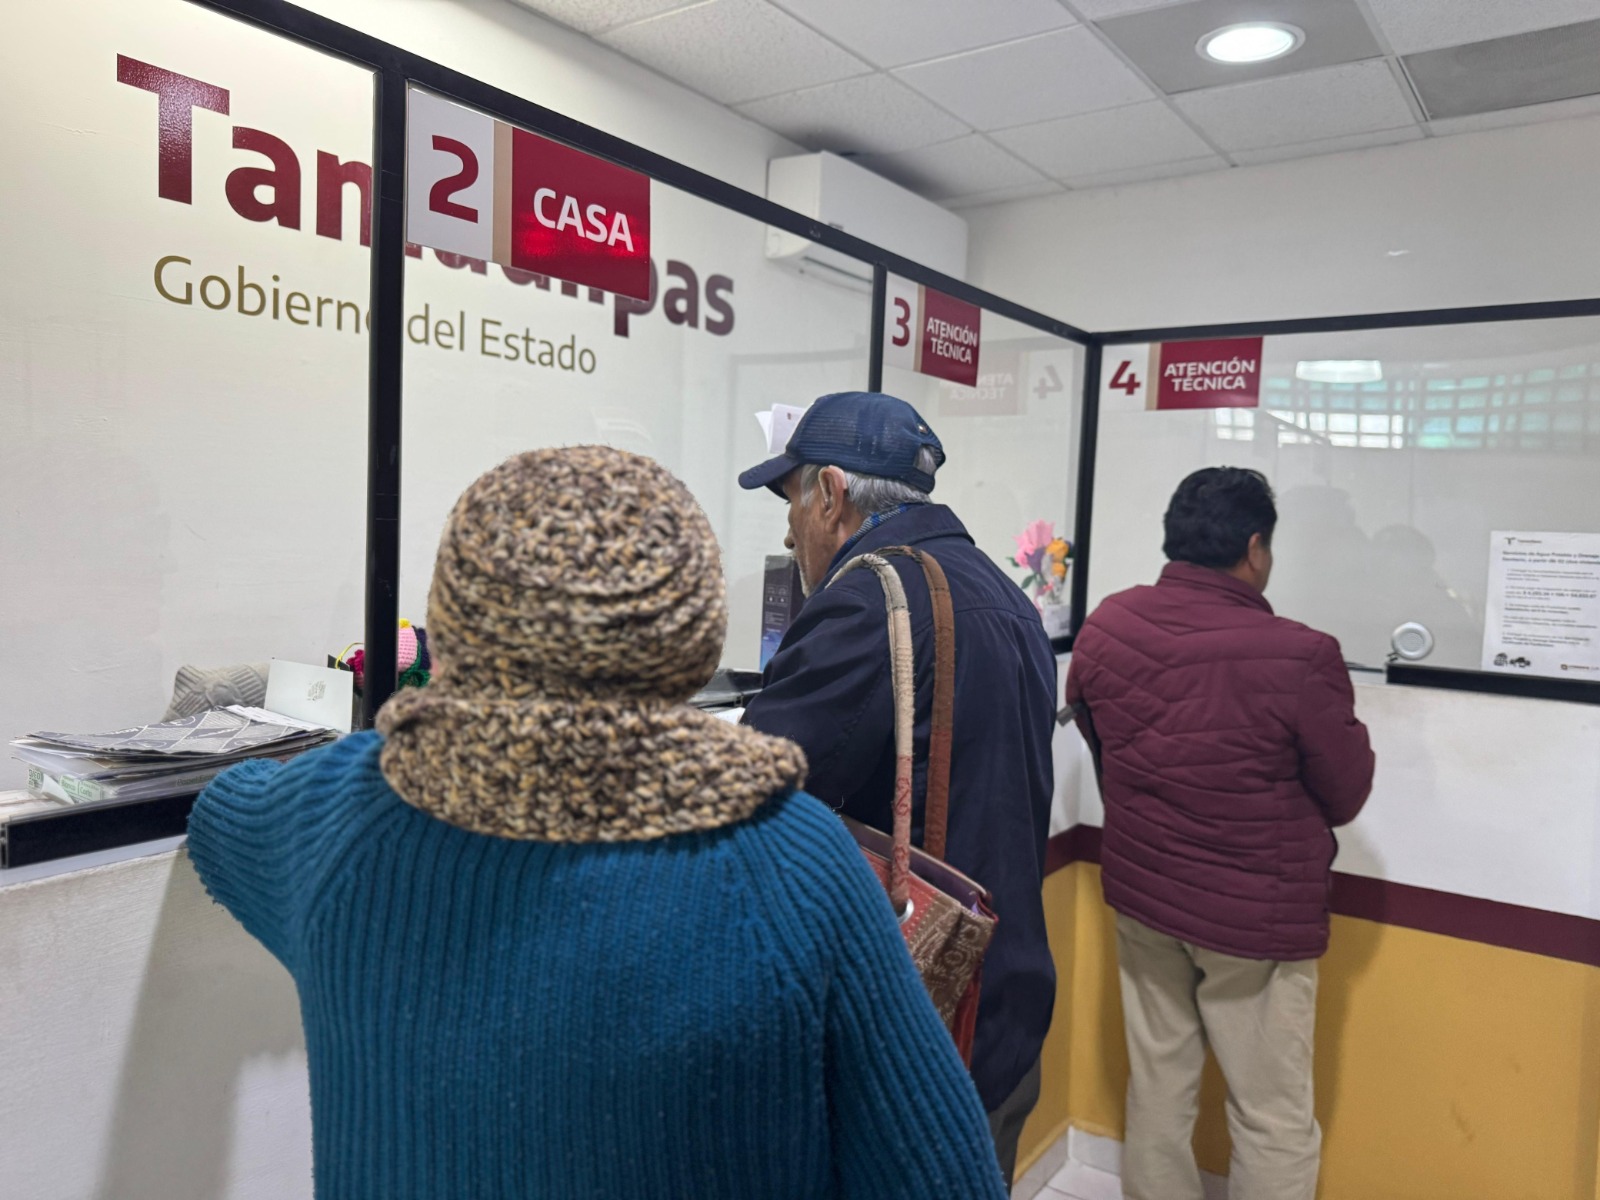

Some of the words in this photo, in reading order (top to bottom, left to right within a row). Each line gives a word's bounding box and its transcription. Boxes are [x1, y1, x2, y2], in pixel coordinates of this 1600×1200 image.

[116, 53, 735, 337] Tampas
[428, 134, 480, 224] 2
[533, 187, 635, 252] CASA
[153, 255, 371, 335] Gobiern
[407, 303, 465, 351] del
[480, 317, 597, 375] Estado
[892, 296, 911, 347] 3
[926, 316, 978, 348] ATENCIÓN
[930, 336, 973, 365] TÉCNICA
[1163, 356, 1256, 378] ATENCIÓN
[1109, 360, 1141, 395] 4
[1171, 374, 1247, 392] TÉCNICA
